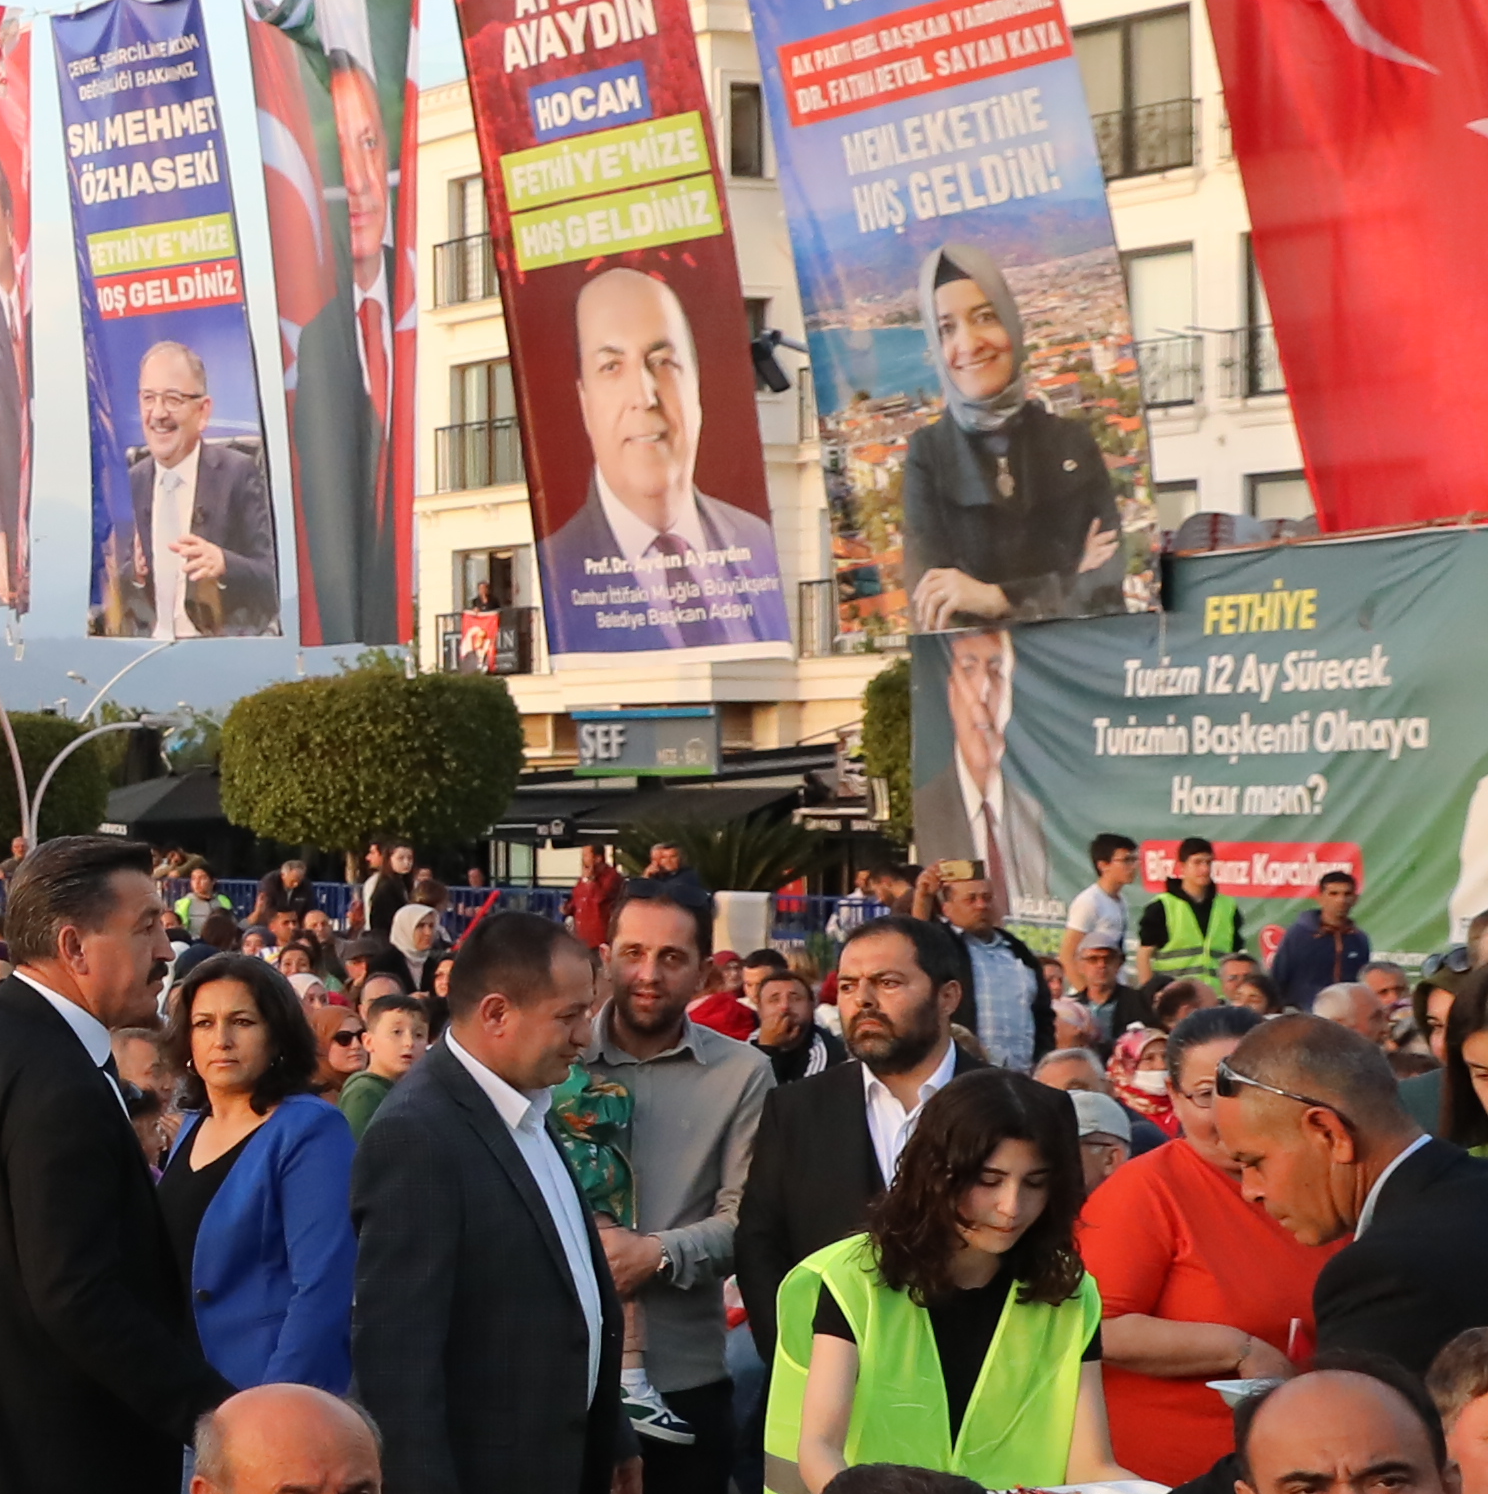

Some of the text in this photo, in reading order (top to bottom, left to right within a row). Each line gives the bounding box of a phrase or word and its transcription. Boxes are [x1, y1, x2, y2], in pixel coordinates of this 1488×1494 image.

[791, 49, 816, 78] AK
[795, 83, 829, 115] DR.
[933, 31, 1008, 77] SAYAN
[1006, 18, 1066, 59] KAYA
[104, 96, 219, 151] MEHMET
[535, 74, 643, 132] HOCAM
[79, 139, 220, 206] ÖZHASEKİ
[510, 126, 700, 200] FETHİYE'MİZE
[852, 140, 1063, 235] HOŞ GELDİN!
[520, 184, 714, 263] HOŞ GELDİNİZ
[128, 263, 238, 309] GELDİNİZ
[651, 579, 701, 604] Muğla
[709, 601, 754, 622] Adayı
[1203, 579, 1318, 635] FETHİYE
[1204, 660, 1234, 696] 12
[1238, 652, 1281, 703] Ay
[580, 723, 627, 767] ŞEF
[1191, 711, 1311, 763] Başkenti
[1313, 707, 1430, 760] Olmaya
